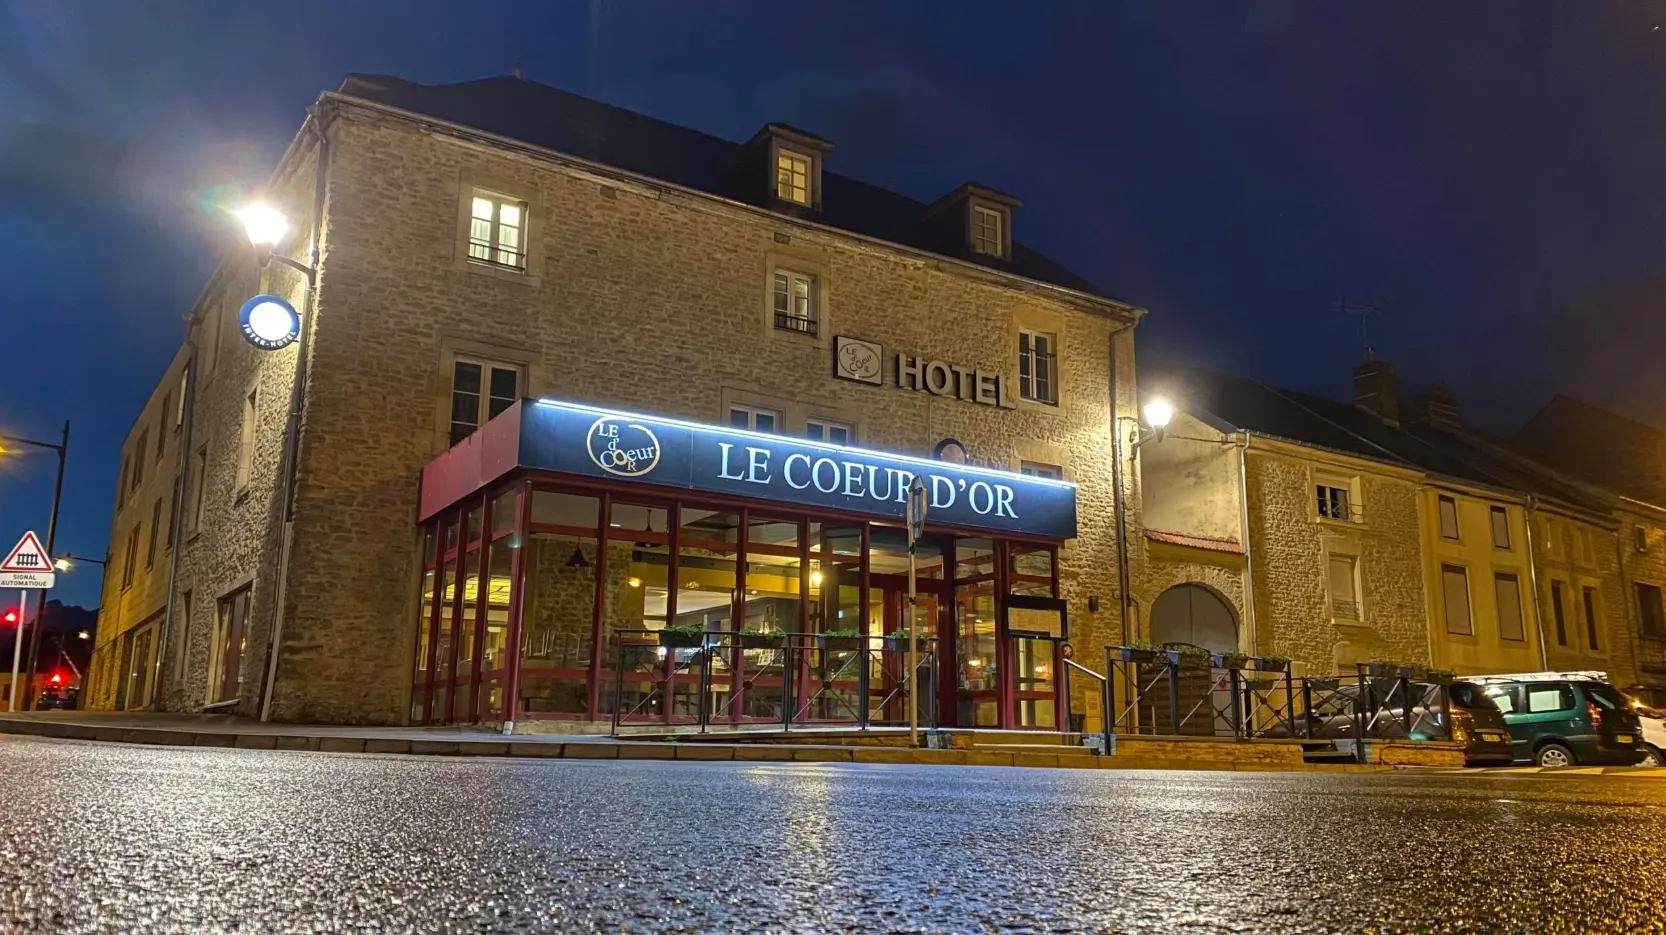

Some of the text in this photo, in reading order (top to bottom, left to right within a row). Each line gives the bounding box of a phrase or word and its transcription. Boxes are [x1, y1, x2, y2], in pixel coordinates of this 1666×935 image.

[242, 323, 297, 348] INTER-HOTEL
[895, 352, 1017, 410] HOTEL
[597, 423, 619, 438] LE
[717, 442, 772, 484] LE
[929, 474, 1019, 519] D'OR
